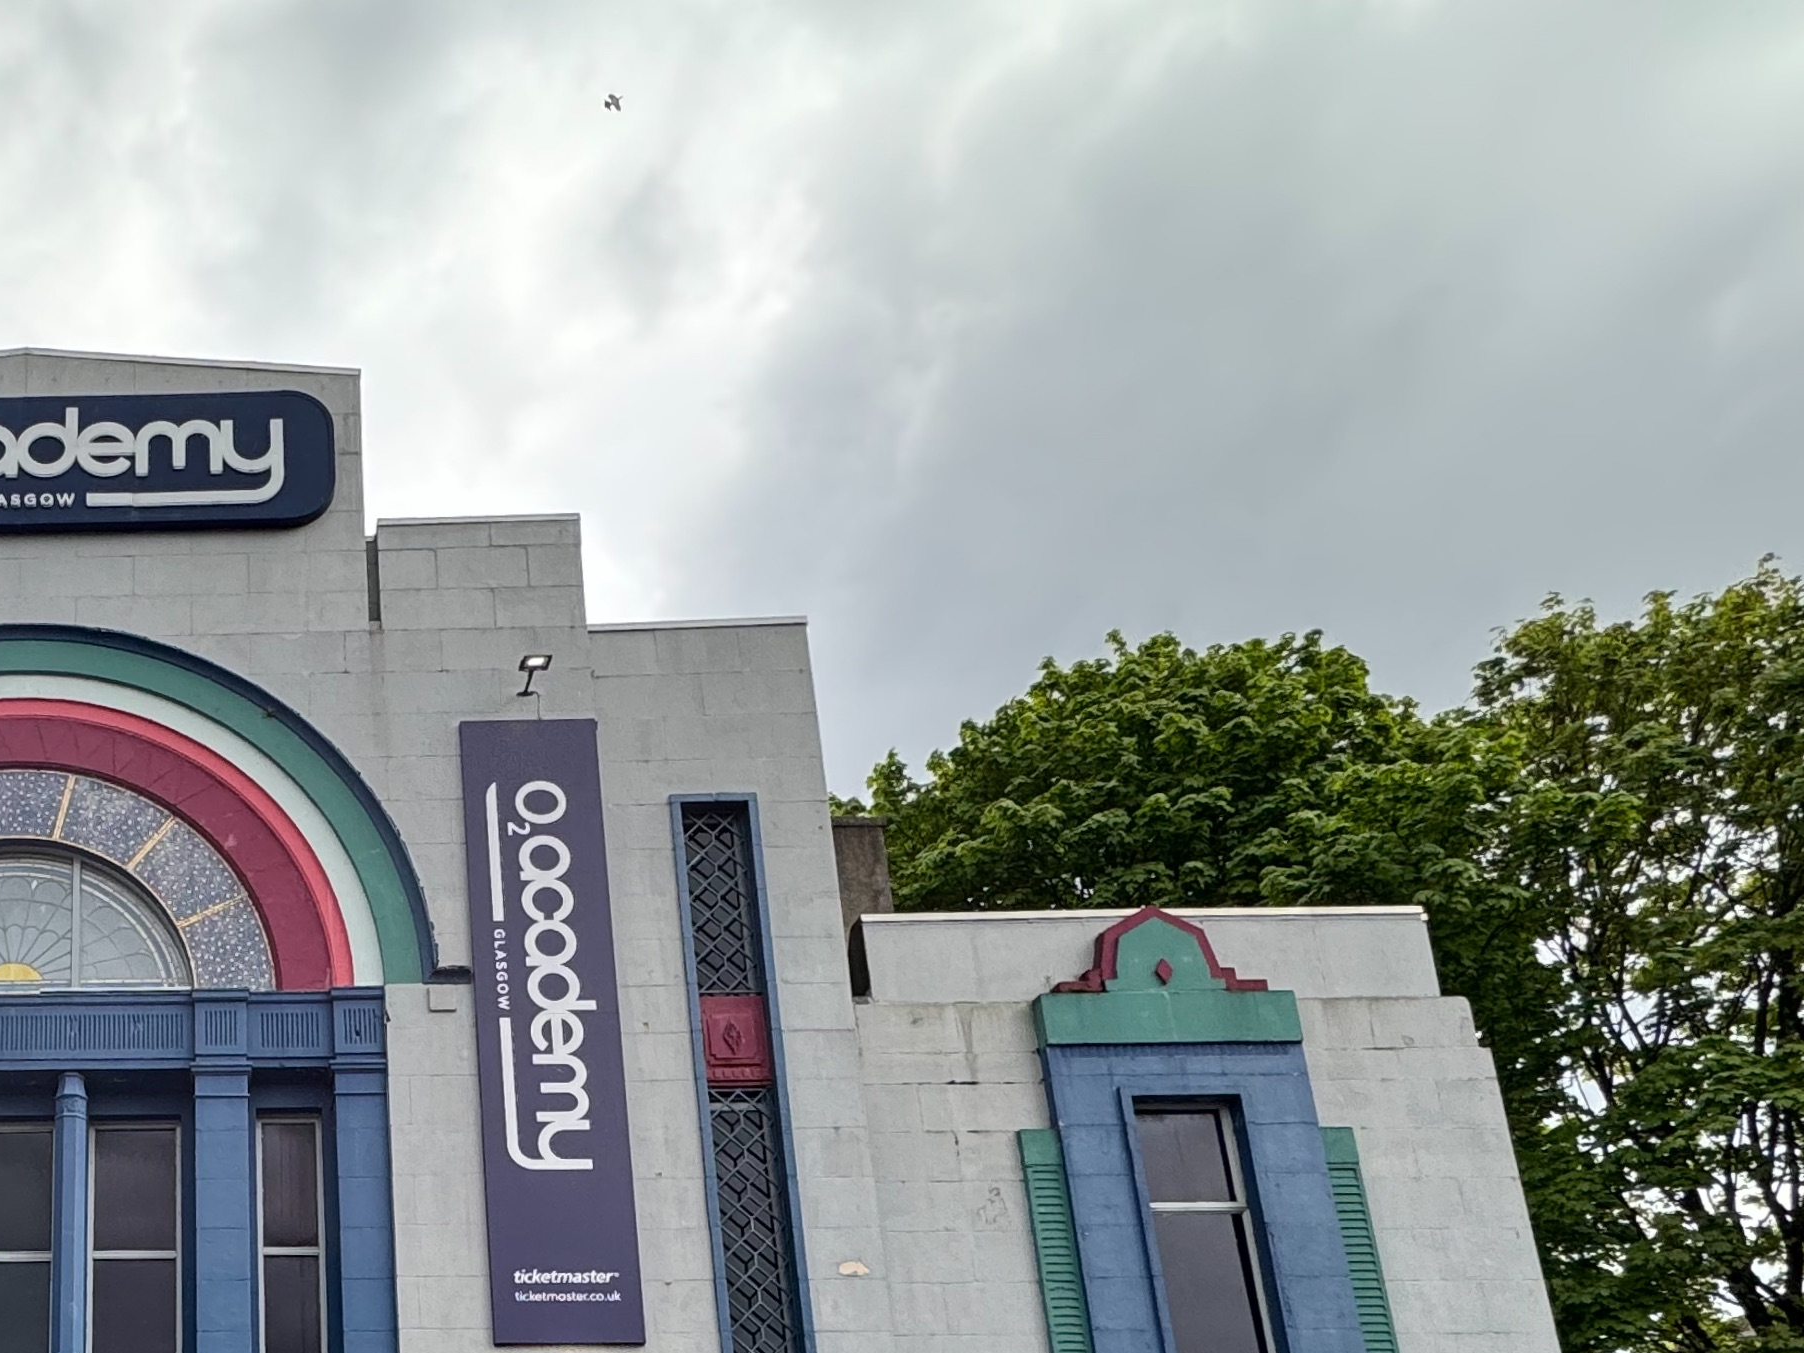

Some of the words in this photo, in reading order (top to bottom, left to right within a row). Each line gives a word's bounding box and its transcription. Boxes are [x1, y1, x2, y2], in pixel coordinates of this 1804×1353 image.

[493, 928, 511, 1011] GLASGOW
[513, 1269, 613, 1284] ticketmaster
[514, 1290, 622, 1302] ticketmaster.co.uk
